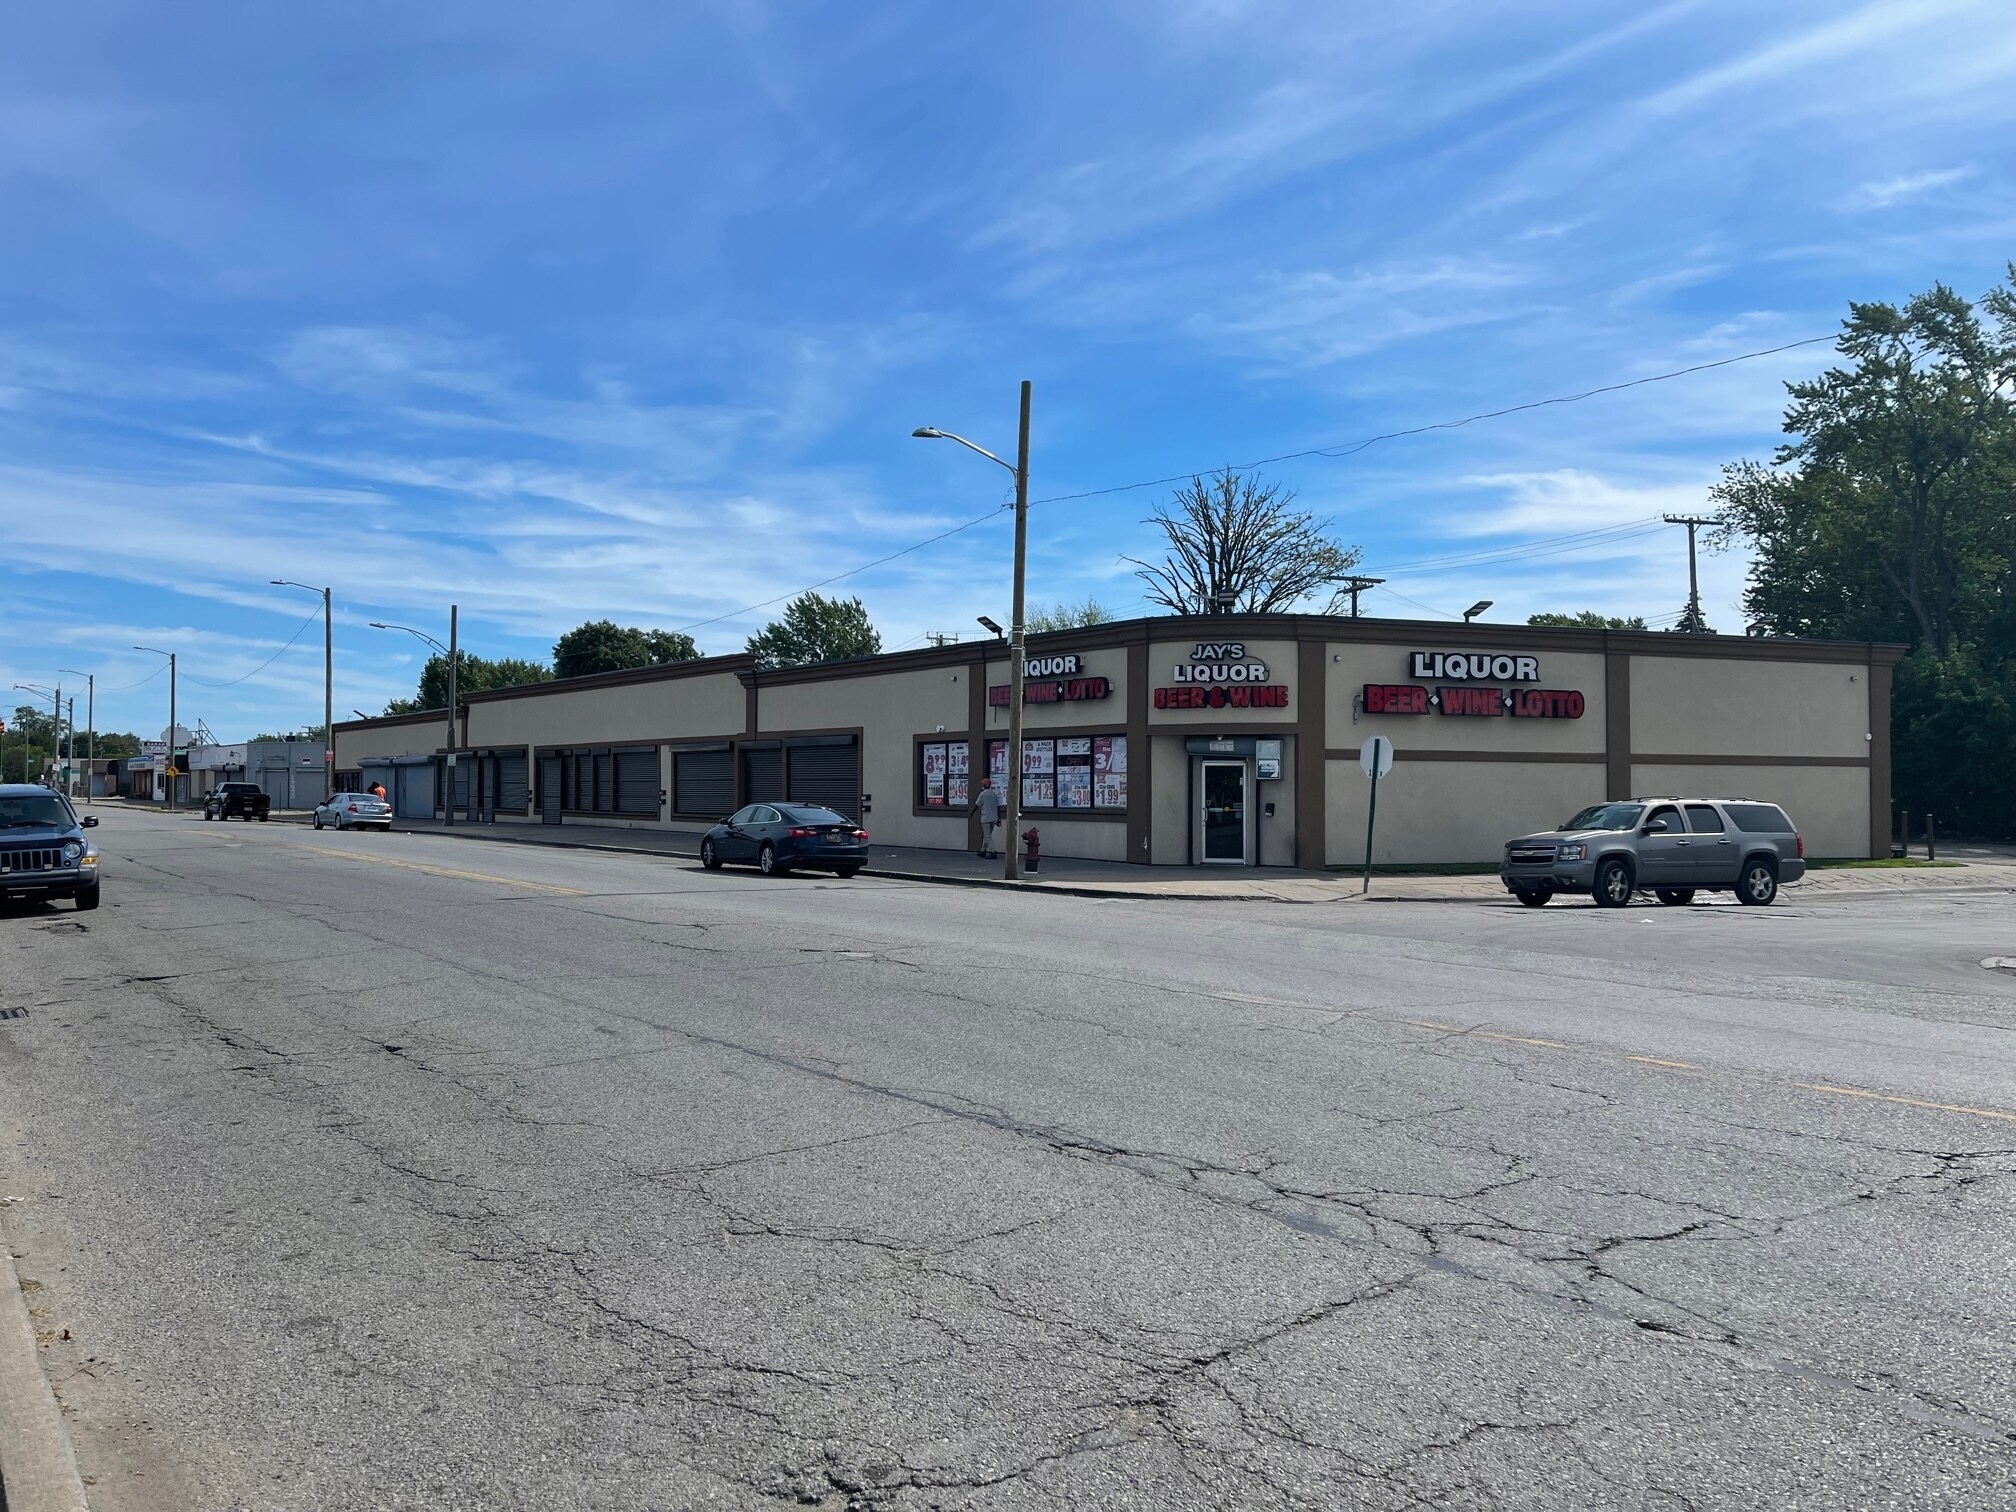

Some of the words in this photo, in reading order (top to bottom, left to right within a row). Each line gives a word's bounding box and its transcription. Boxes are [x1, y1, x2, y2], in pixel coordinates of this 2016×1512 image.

[1191, 644, 1244, 659] JAY'S
[1023, 656, 1076, 677] IQUOR
[1174, 664, 1266, 682] LIQUOR
[1415, 654, 1537, 680] LIQUOR
[990, 687, 1011, 705] BEE
[1025, 683, 1056, 703] WINE
[1064, 679, 1105, 701] LOTTO
[1155, 687, 1207, 708] BEER
[1208, 687, 1226, 708] &
[1229, 686, 1289, 708] WINE
[1367, 686, 1429, 713] BEER
[1440, 688, 1502, 716] WINE
[1515, 690, 1584, 718] LOTTO
